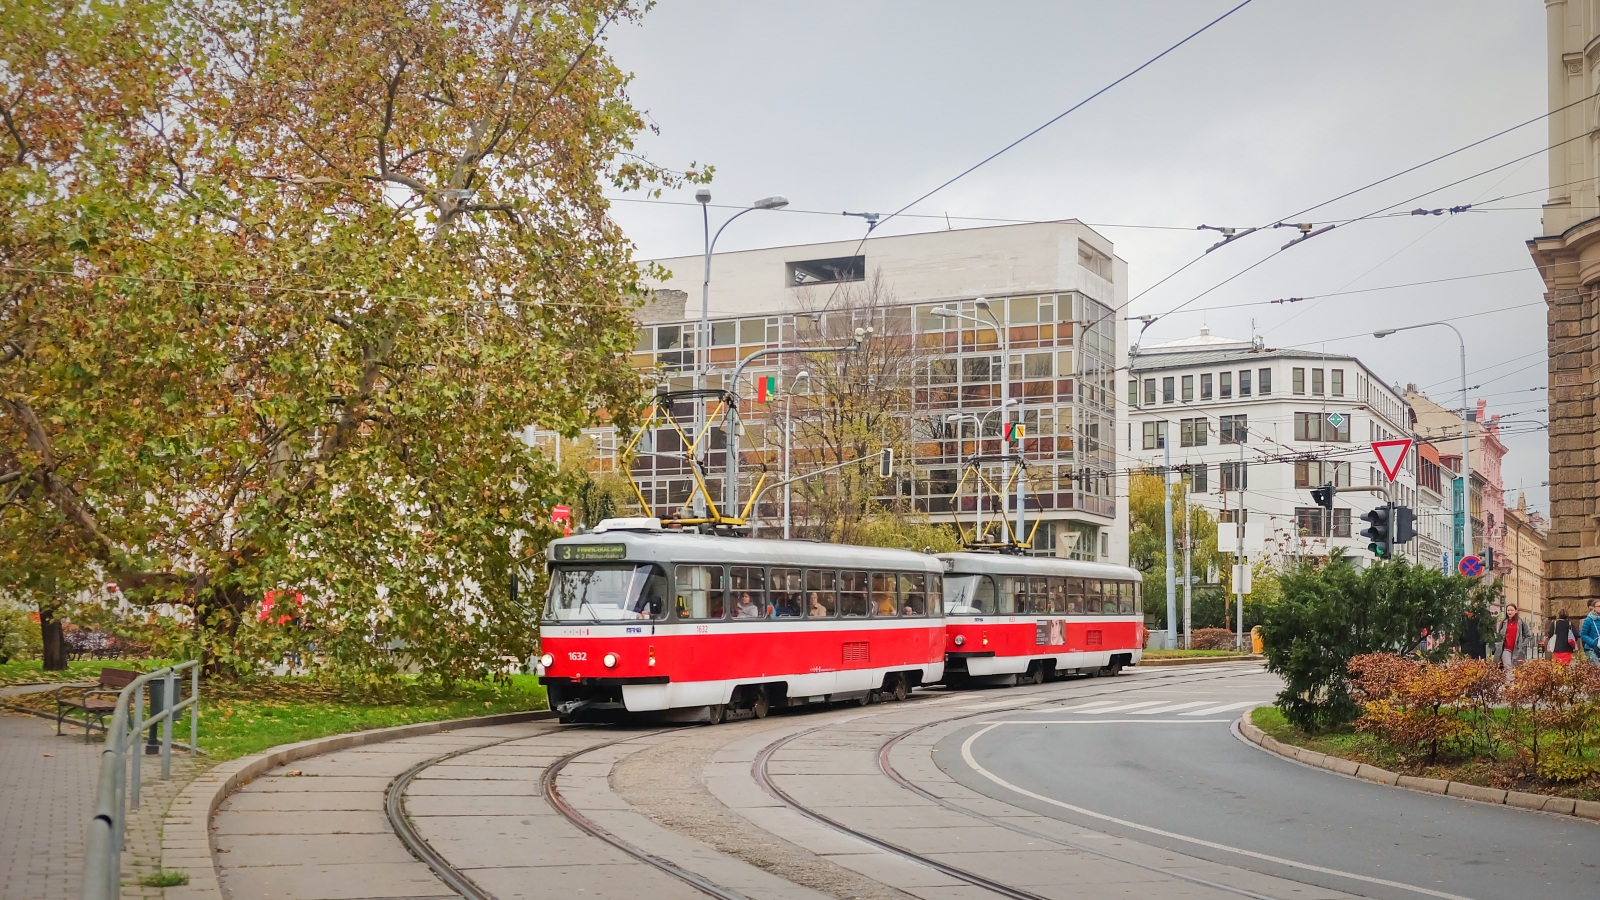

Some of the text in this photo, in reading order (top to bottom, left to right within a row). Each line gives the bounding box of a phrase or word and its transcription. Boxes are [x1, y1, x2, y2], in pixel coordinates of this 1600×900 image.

[563, 546, 571, 559] 3
[696, 625, 708, 633] 1632
[568, 652, 587, 661] 1632
